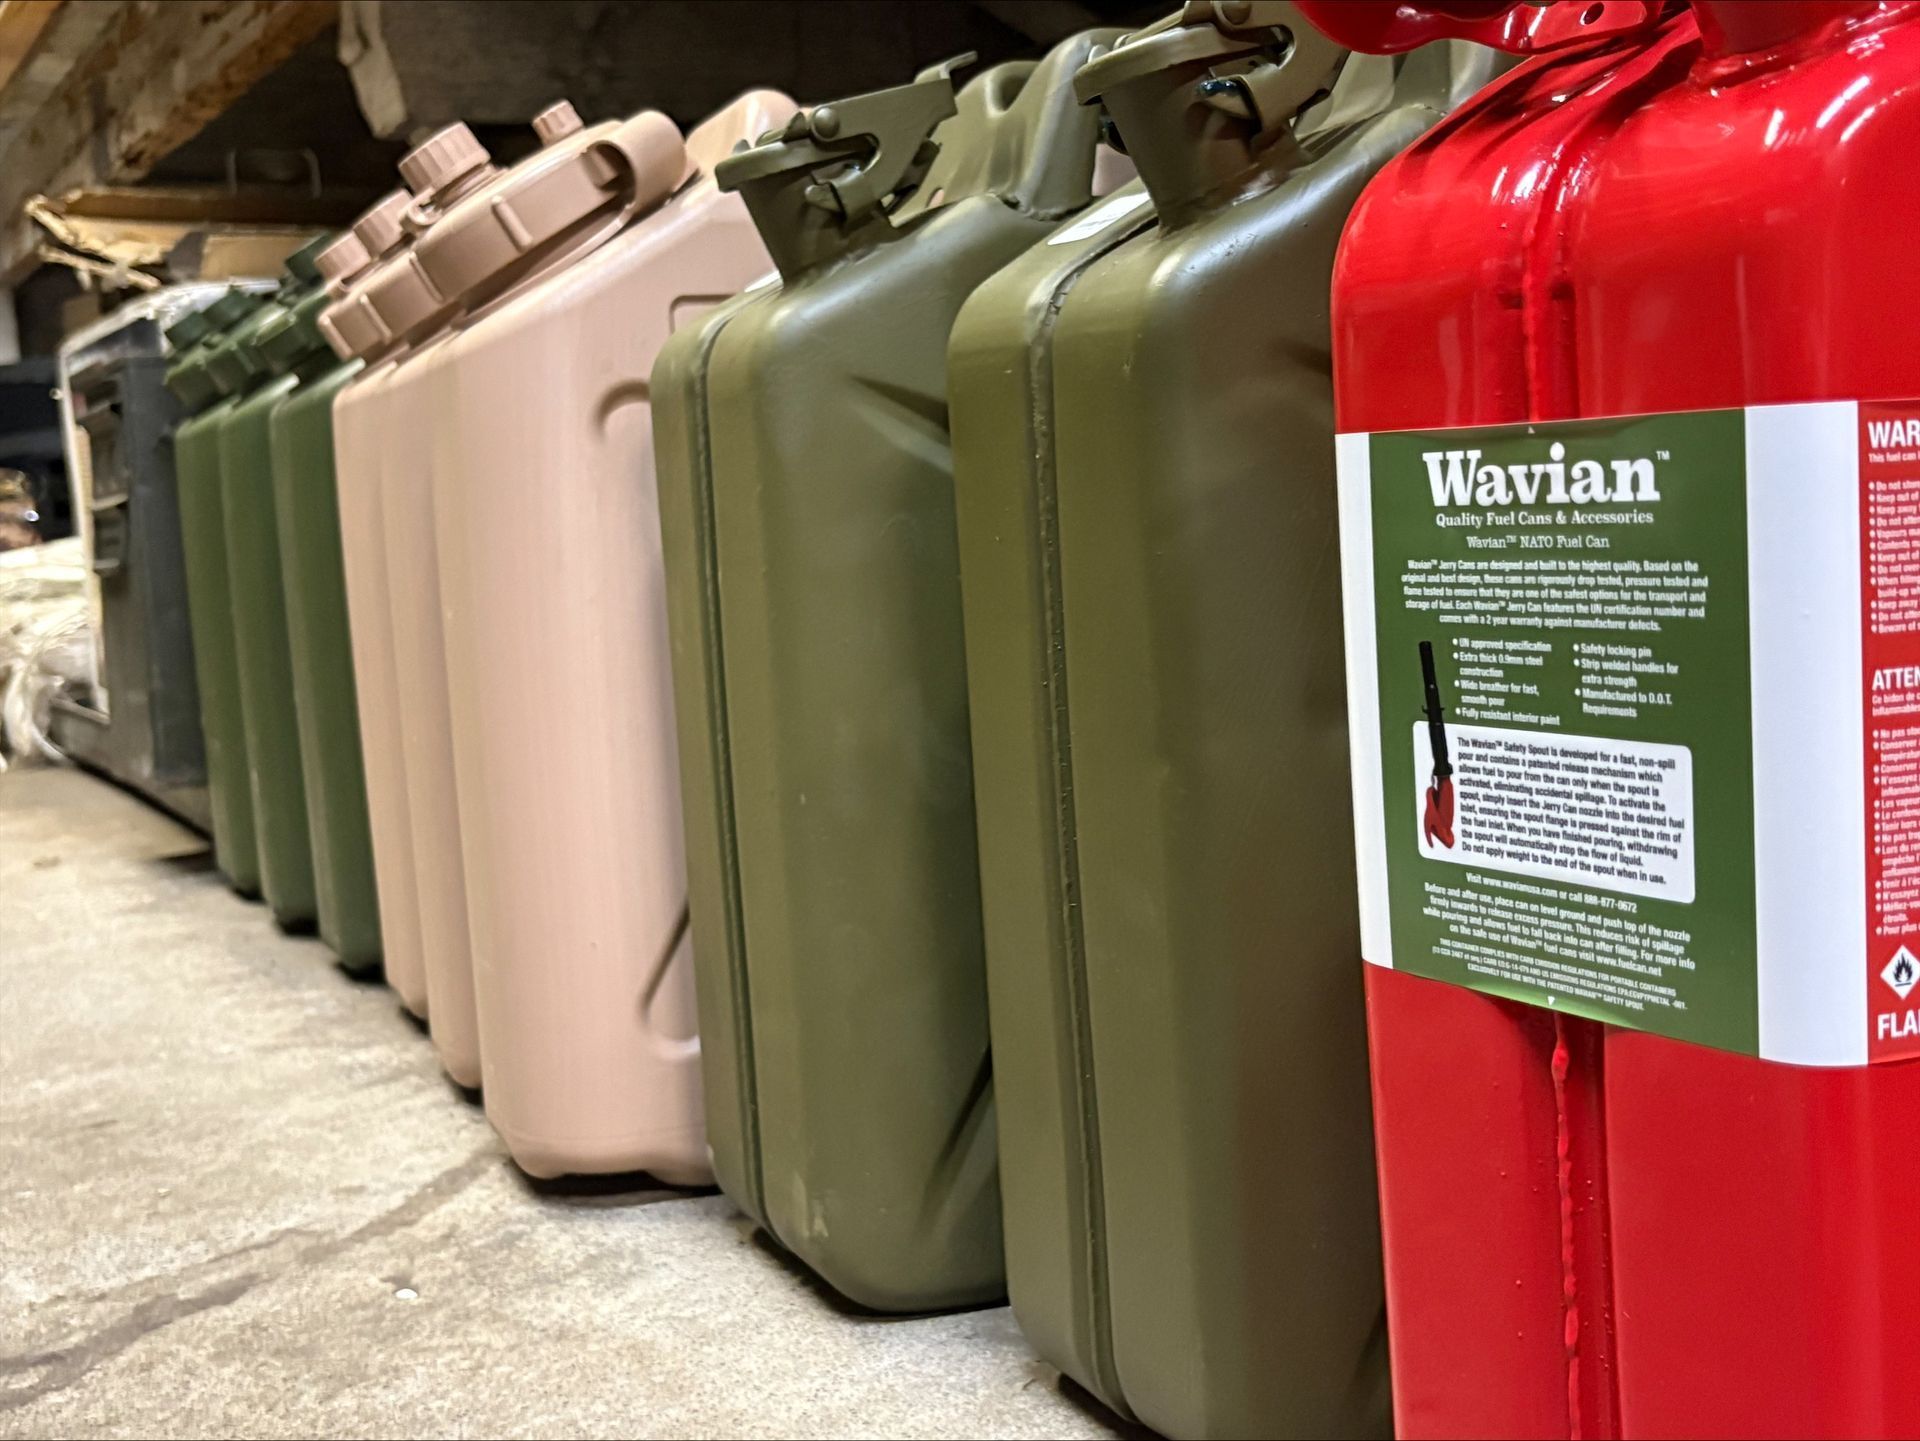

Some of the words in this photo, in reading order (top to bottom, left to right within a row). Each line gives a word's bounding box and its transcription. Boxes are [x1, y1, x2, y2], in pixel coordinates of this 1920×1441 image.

[1902, 452, 1916, 461] can
[1436, 512, 1481, 527] Quality
[1486, 511, 1514, 525] Fuel
[1518, 511, 1552, 524] Cans
[1555, 510, 1566, 523] &
[1571, 510, 1653, 523] Accessories
[1520, 535, 1553, 547] NATO
[1557, 535, 1582, 547] Fuel
[1585, 535, 1609, 547] Can
[1648, 692, 1673, 704] D.O.T.
[1458, 736, 1469, 747] The
[1504, 741, 1526, 754] Safety
[1528, 744, 1549, 755] Spout
[1550, 746, 1557, 756] is
[1559, 748, 1597, 760] developed
[1599, 751, 1610, 761] for
[1638, 758, 1675, 769] non-spill
[1458, 752, 1473, 760] pour
[1475, 753, 1488, 762] and
[1489, 755, 1519, 765] contains
[1527, 759, 1560, 770] patented
[1561, 763, 1589, 773] release
[1590, 766, 1635, 778] mechanism
[1637, 771, 1662, 781] which
[1459, 763, 1480, 774] allows
[1482, 766, 1495, 776] fuel
[1497, 768, 1504, 777] to
[1505, 770, 1521, 779] pour
[1523, 771, 1541, 781] from
[1542, 773, 1554, 783] the
[1556, 776, 1570, 785] can
[1571, 777, 1587, 789] only
[1590, 779, 1611, 790] when
[1612, 781, 1625, 792] the
[1627, 785, 1649, 795] spout
[1651, 786, 1659, 796] is
[1482, 793, 1504, 805] simply
[1506, 796, 1526, 806] insert
[1528, 798, 1540, 808] the
[1542, 800, 1560, 813] Jerry
[1562, 802, 1577, 813] Can
[1578, 807, 1603, 817] nozzle
[1604, 808, 1619, 820] into
[1621, 811, 1634, 822] the
[1636, 813, 1666, 826] desired
[1668, 817, 1685, 828] fuel
[1493, 781, 1533, 796] eliminating
[1534, 787, 1572, 799] accidental
[1608, 794, 1616, 805] To
[1618, 798, 1650, 809] activate
[1652, 801, 1665, 811] the
[1461, 815, 1472, 825] the
[1473, 817, 1486, 827] fuel
[1506, 822, 1526, 833] When
[1528, 827, 1541, 836] you
[1542, 828, 1560, 838] have
[1562, 830, 1592, 843] finished
[1626, 841, 1678, 858] withdrawing
[1478, 807, 1508, 819] ensuring
[1510, 809, 1521, 819] the
[1523, 813, 1543, 822] spout
[1545, 814, 1568, 827] flange
[1570, 818, 1576, 827] is
[1578, 821, 1608, 832] pressed
[1610, 825, 1639, 836] against
[1641, 828, 1654, 839] the
[1656, 830, 1670, 841] rim
[1672, 832, 1682, 842] of
[1461, 828, 1472, 838] the
[1474, 832, 1493, 841] spout
[1495, 834, 1507, 843] will
[1509, 837, 1557, 852] automatically
[1559, 844, 1575, 856] stop
[1577, 846, 1589, 857] the
[1591, 848, 1607, 860] flow
[1609, 852, 1617, 861] of
[1462, 841, 1471, 851] Do
[1472, 844, 1484, 853] not
[1485, 847, 1504, 858] apply
[1506, 850, 1530, 861] weight
[1531, 853, 1538, 862] to
[1540, 854, 1552, 864] the
[1554, 858, 1567, 867] end
[1569, 859, 1577, 868] of
[1578, 860, 1591, 871] the
[1593, 864, 1614, 875] spout
[1616, 868, 1637, 879] when
[1639, 870, 1647, 881] in
[1878, 1008, 1920, 1040] FLA
